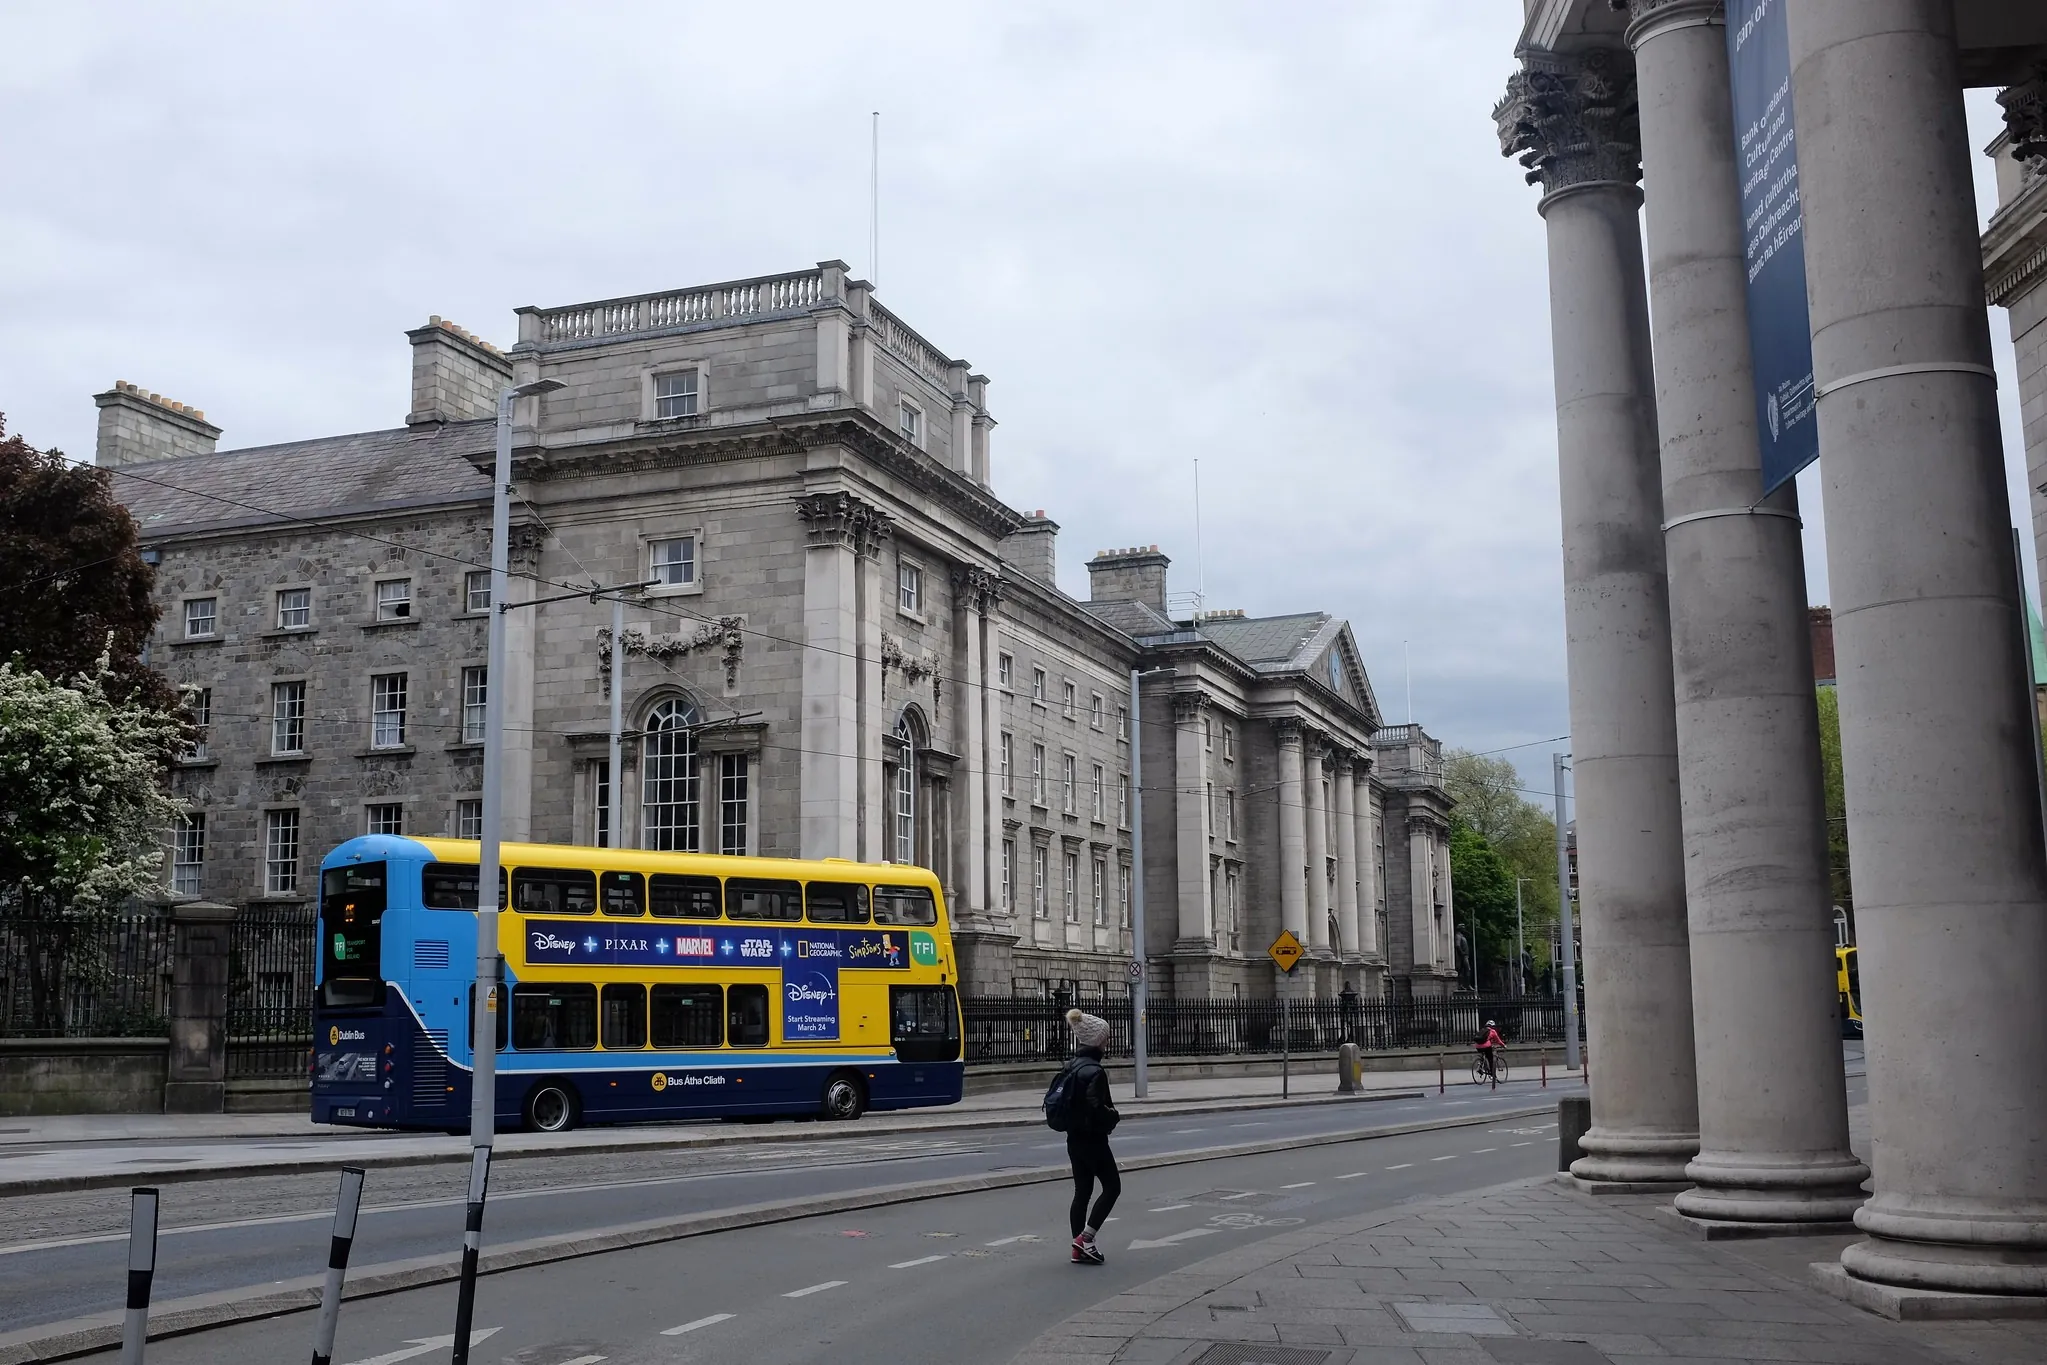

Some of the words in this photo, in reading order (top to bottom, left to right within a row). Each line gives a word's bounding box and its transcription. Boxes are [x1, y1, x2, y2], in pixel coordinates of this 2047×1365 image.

[1772, 107, 1786, 136] and
[1741, 121, 1759, 151] Bank
[1769, 129, 1794, 165] Centre
[1759, 187, 1801, 240] Oidhreacht
[1764, 245, 1774, 262] na
[335, 942, 345, 952] TFI
[605, 939, 649, 951] PIXAR
[677, 938, 714, 955] MARVEL
[741, 939, 772, 949] STAR
[809, 942, 836, 950] NATIONAL
[914, 942, 934, 955] TFI
[740, 948, 773, 958] WARS
[809, 949, 843, 958] GEOGRAPHIC
[787, 1015, 803, 1023] Start
[804, 1014, 836, 1024] Streaming
[797, 1023, 817, 1031] March
[818, 1023, 826, 1031] 24
[338, 1030, 355, 1040] Dublin
[355, 1030, 365, 1040] Bus
[667, 1077, 684, 1086] Bus
[684, 1074, 702, 1086] Átha
[703, 1075, 726, 1085] Cliath
